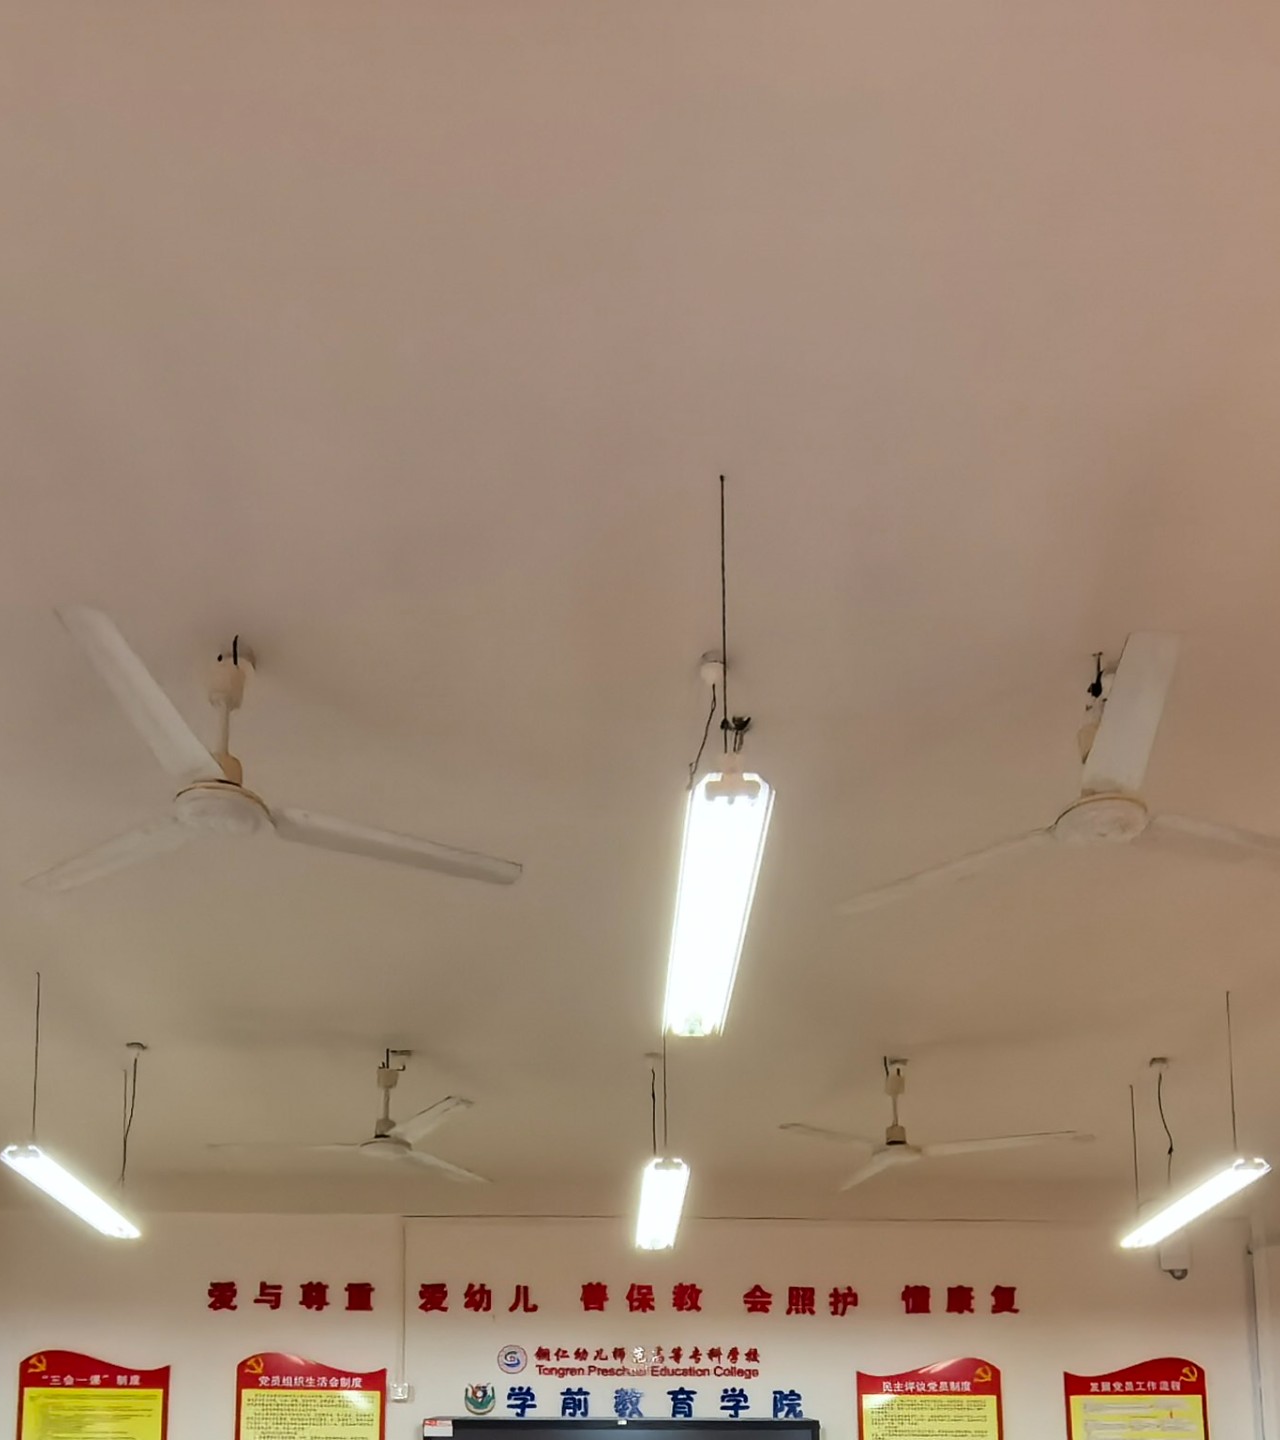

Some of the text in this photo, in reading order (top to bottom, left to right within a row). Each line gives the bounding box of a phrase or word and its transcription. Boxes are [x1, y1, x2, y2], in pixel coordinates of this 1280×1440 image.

[207, 1281, 375, 1312] 爱与尊重
[418, 1282, 539, 1313] 爱幼儿
[580, 1281, 703, 1313] 善保教
[743, 1284, 859, 1317] 会照护
[535, 1364, 584, 1378] Tongren
[650, 1364, 710, 1378] Education
[713, 1364, 760, 1379] College
[258, 1375, 363, 1388] 党员组织生活会制度
[882, 1381, 973, 1393] 民主评议党员制度
[507, 1386, 804, 1419] 学前教育学院
